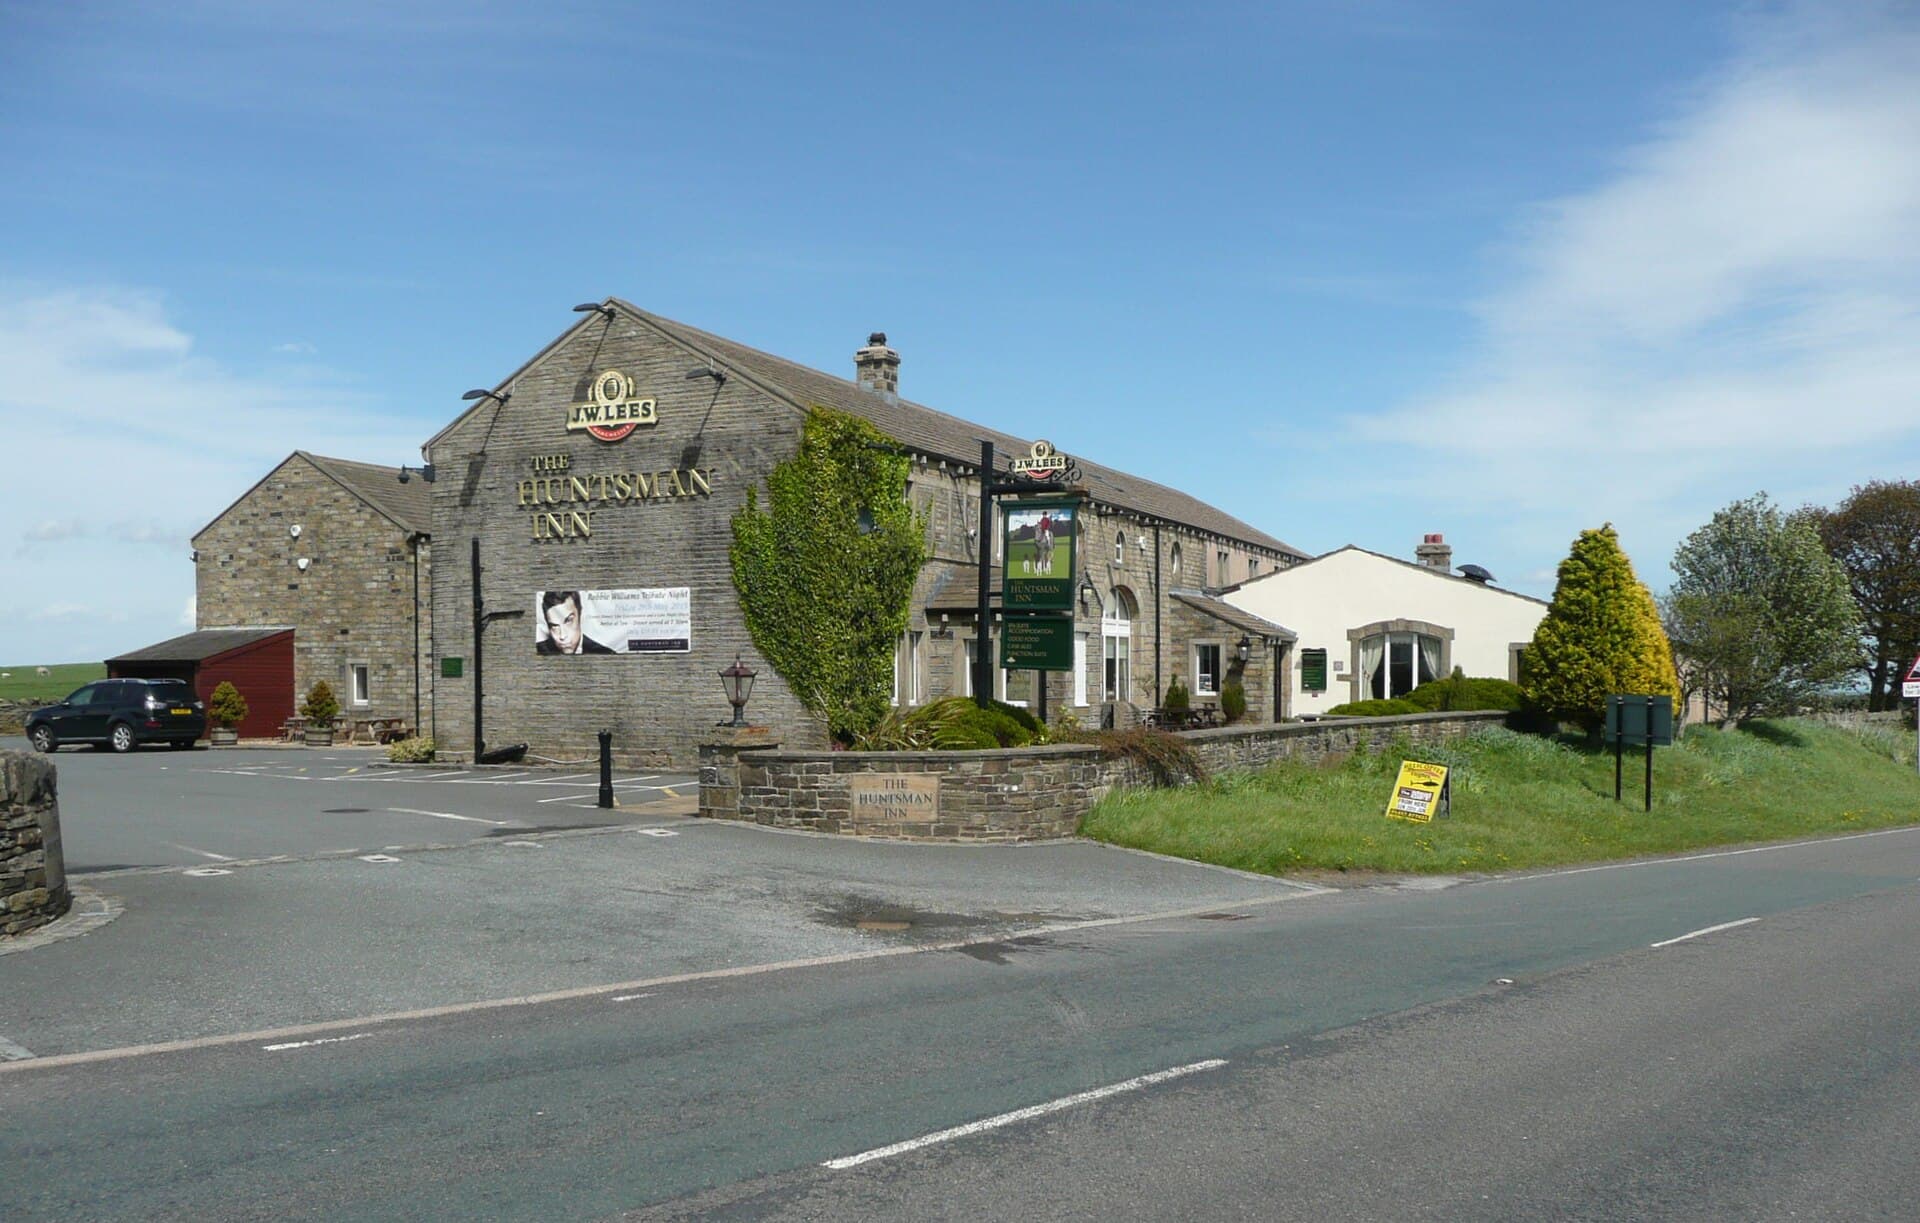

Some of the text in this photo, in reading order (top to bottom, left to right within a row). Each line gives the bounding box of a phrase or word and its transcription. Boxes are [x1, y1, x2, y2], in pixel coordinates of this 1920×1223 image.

[531, 455, 569, 471] THE
[518, 468, 714, 506] HUNTSMAN
[531, 511, 594, 539] INN
[587, 589, 688, 601] Robbie Williams Tribute Night
[1010, 585, 1060, 593] HUNTSMAN
[1015, 594, 1032, 602] INN
[883, 779, 908, 789] THE
[859, 793, 933, 805] HUNTSMAN
[884, 808, 908, 818] INN
